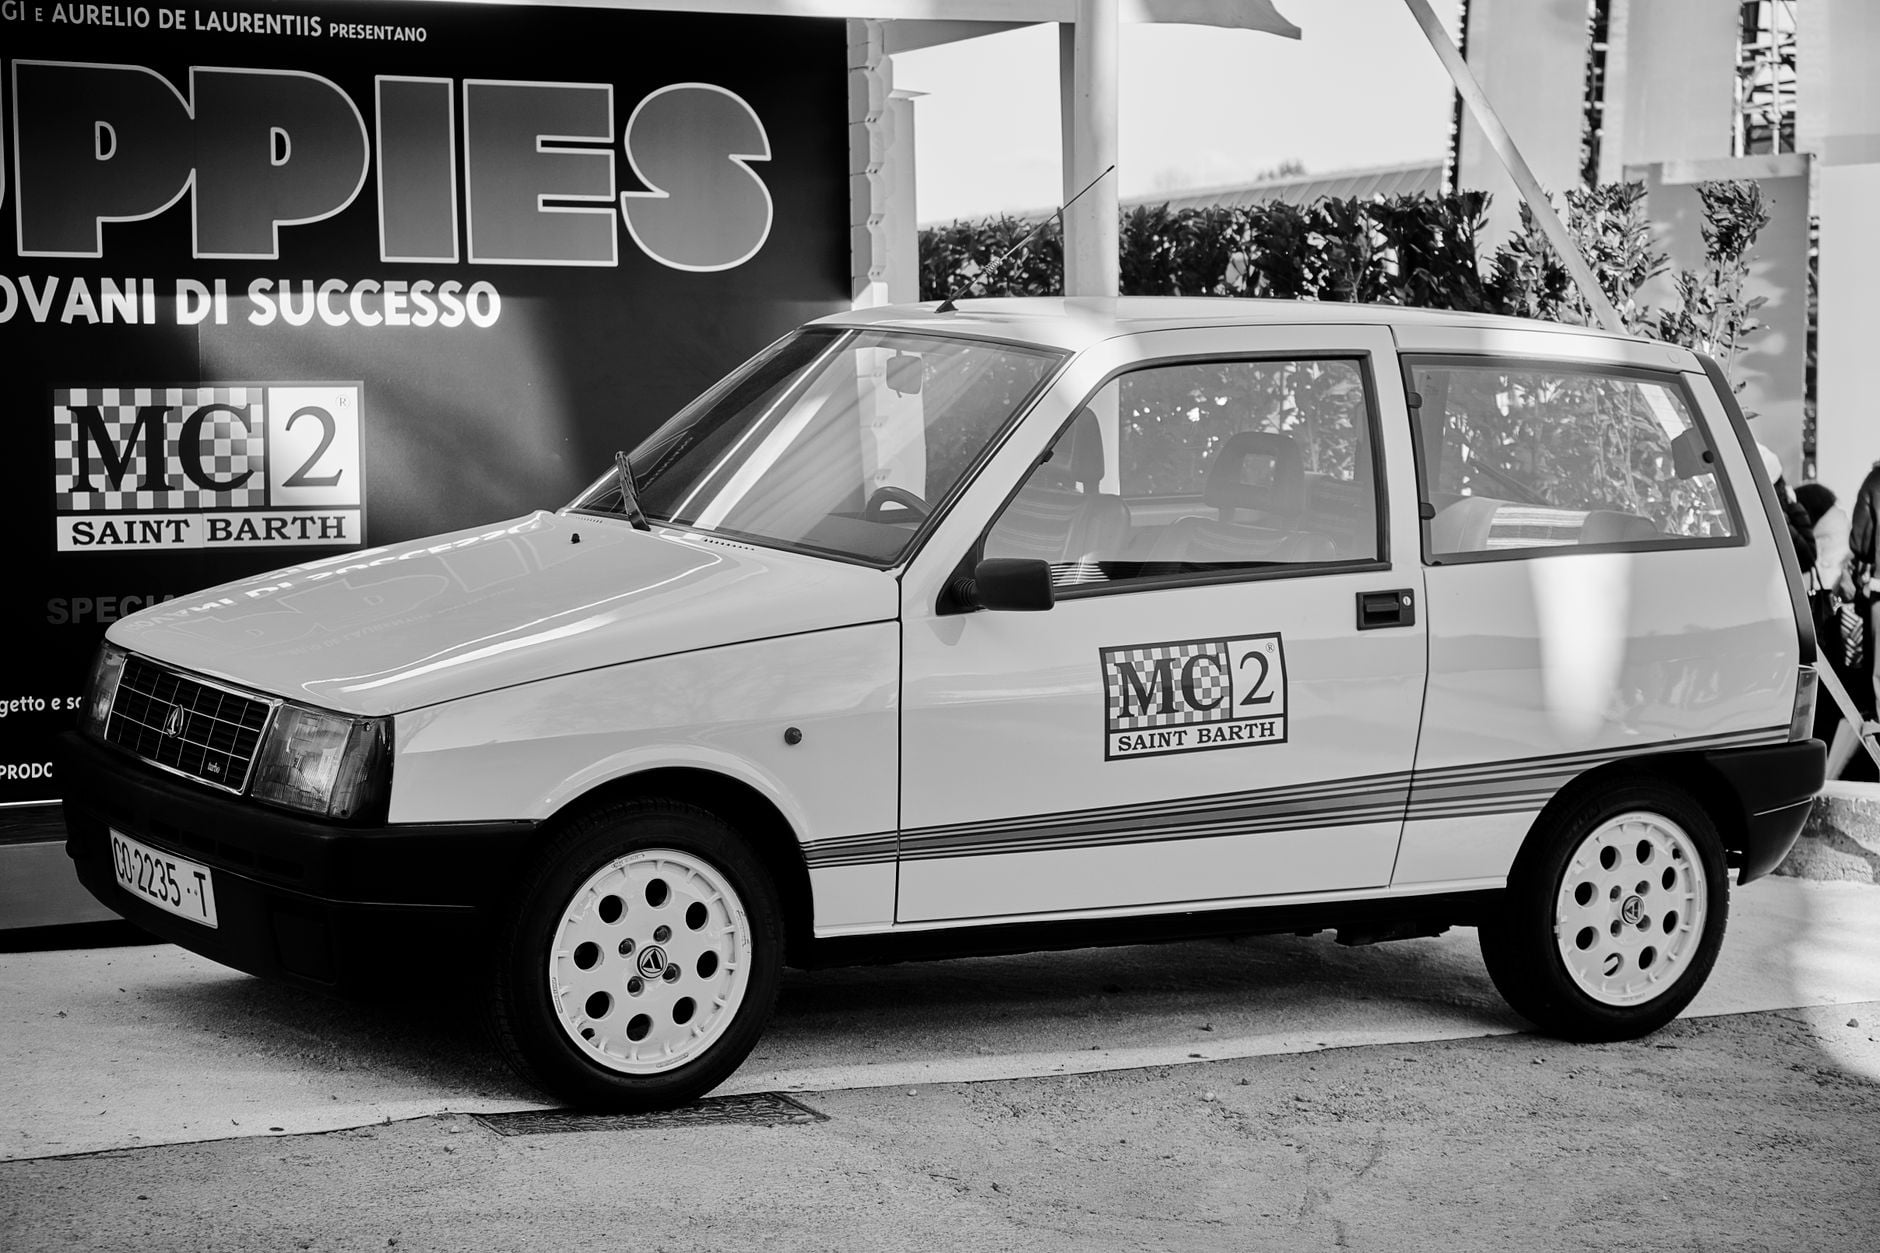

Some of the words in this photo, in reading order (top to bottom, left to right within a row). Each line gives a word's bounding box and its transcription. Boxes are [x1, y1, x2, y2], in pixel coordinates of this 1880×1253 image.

[1, 0, 25, 21] GI
[51, 2, 150, 28] AURELIO
[159, 8, 187, 30] DE
[195, 10, 322, 37] LAURENTIIS
[329, 23, 427, 42] PRESENTANO
[0, 58, 774, 273] PPIES
[176, 278, 228, 325] DI
[247, 277, 502, 328] SUCCESSO
[71, 518, 191, 546] SAINT
[206, 515, 347, 543] BARTH
[51, 697, 62, 711] e
[1117, 729, 1188, 752] SAINT
[1197, 721, 1276, 745] BARTH
